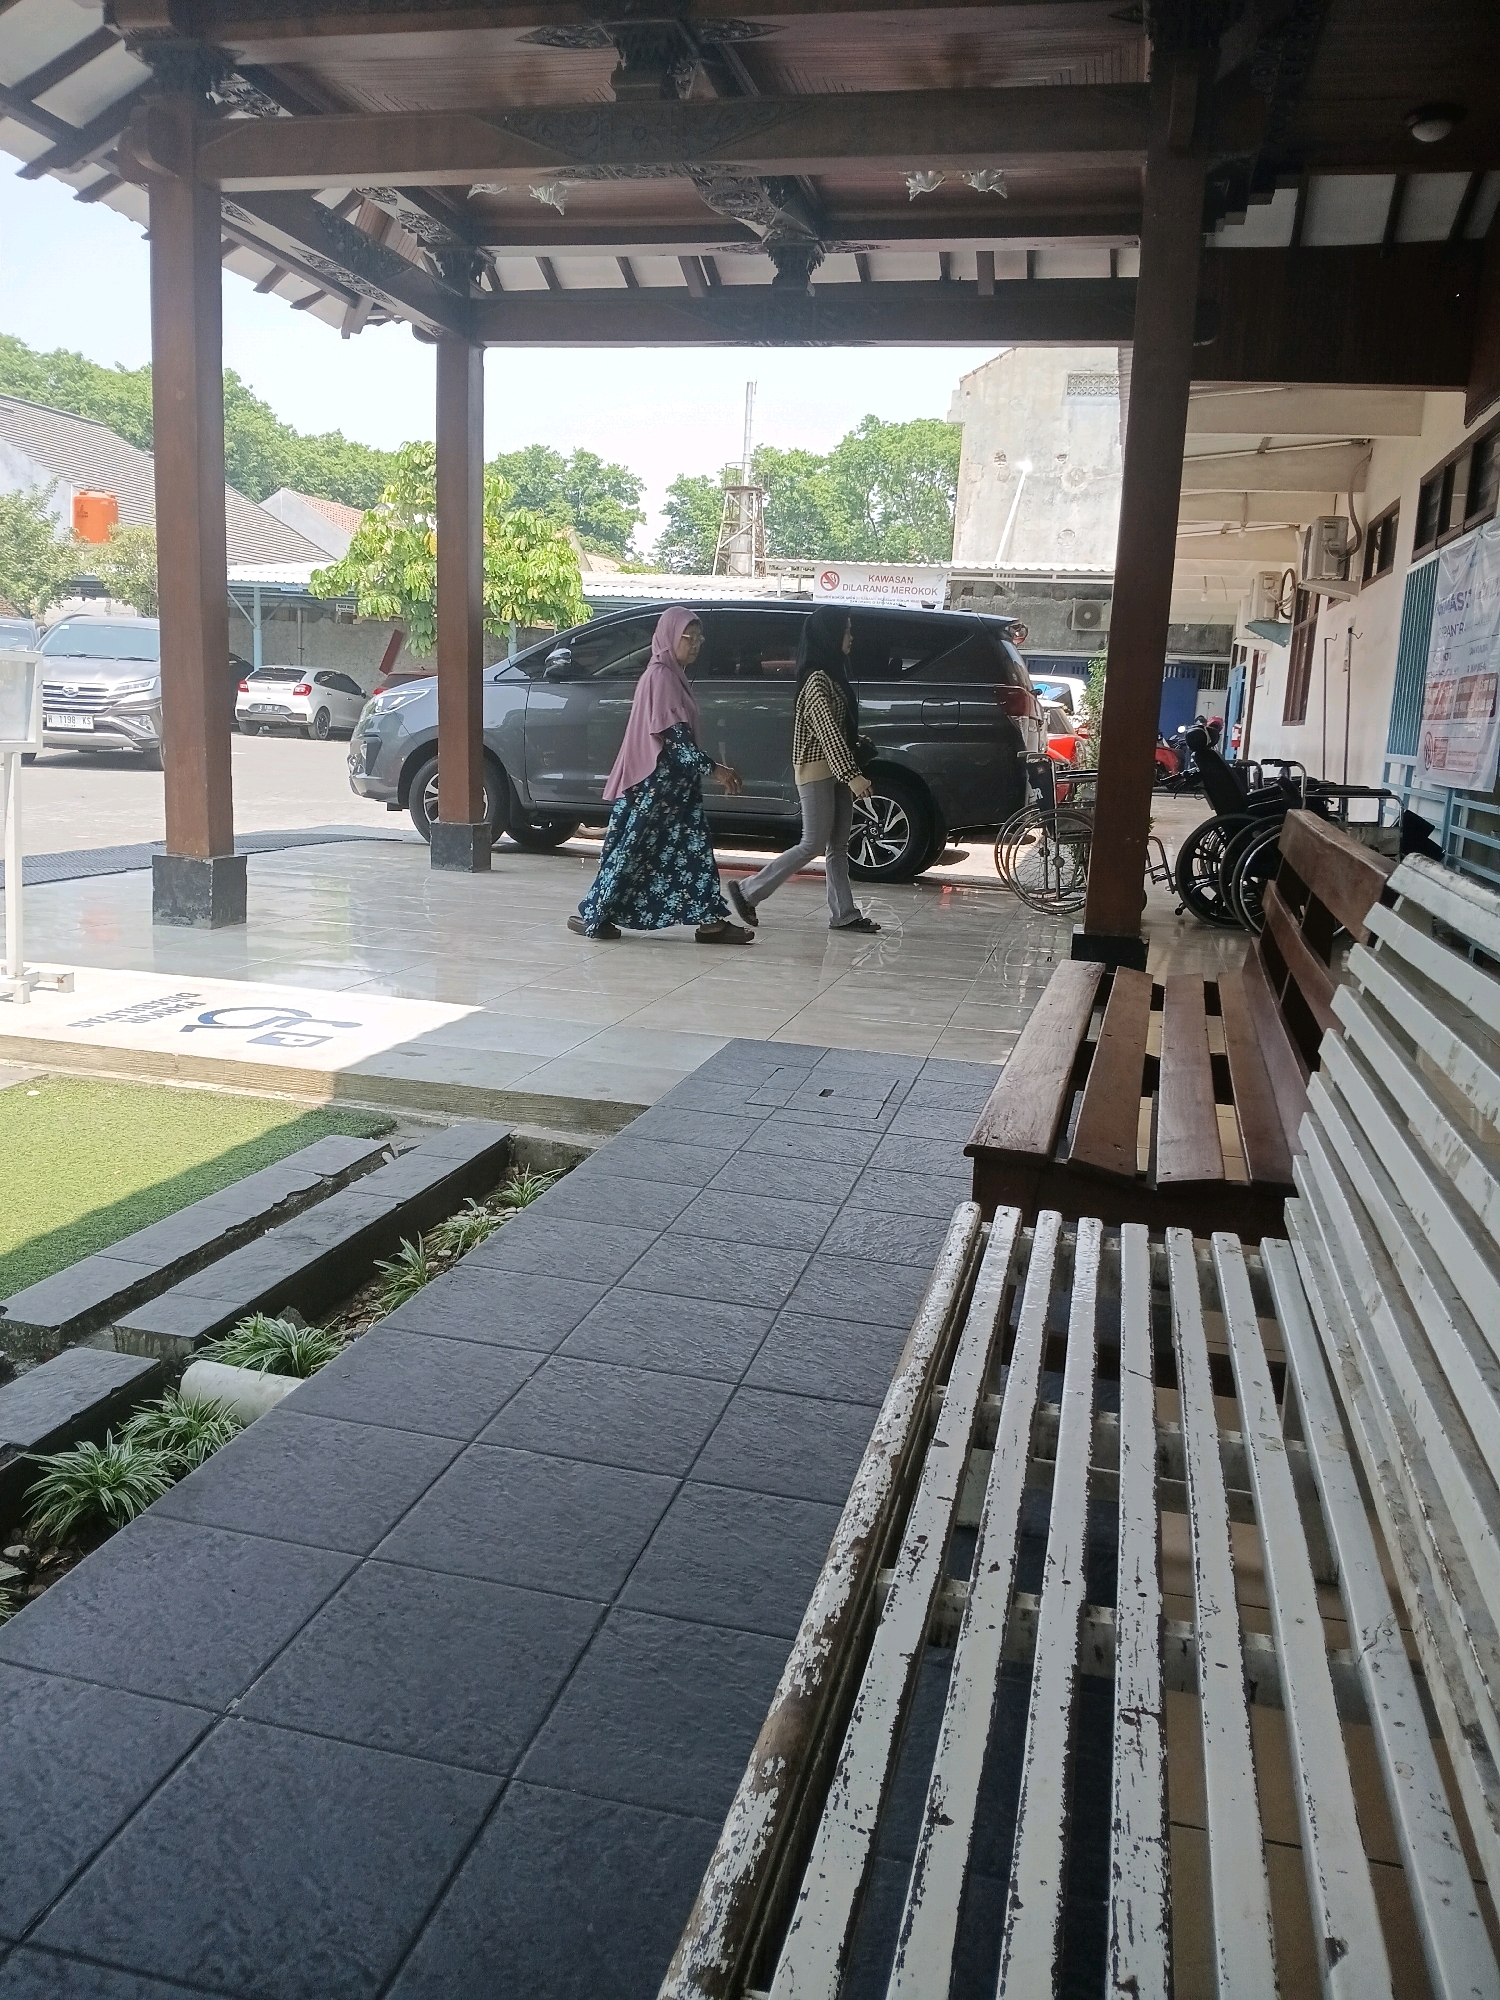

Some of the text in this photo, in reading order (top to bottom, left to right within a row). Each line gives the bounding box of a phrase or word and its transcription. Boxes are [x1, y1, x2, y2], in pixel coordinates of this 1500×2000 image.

[868, 575, 914, 584] KAWASAN
[842, 584, 938, 596] DILARANG MEROKOK
[59, 715, 76, 724] 1198
[66, 992, 203, 1028] DISABILITAS
[118, 1001, 207, 1024] PARKIR
